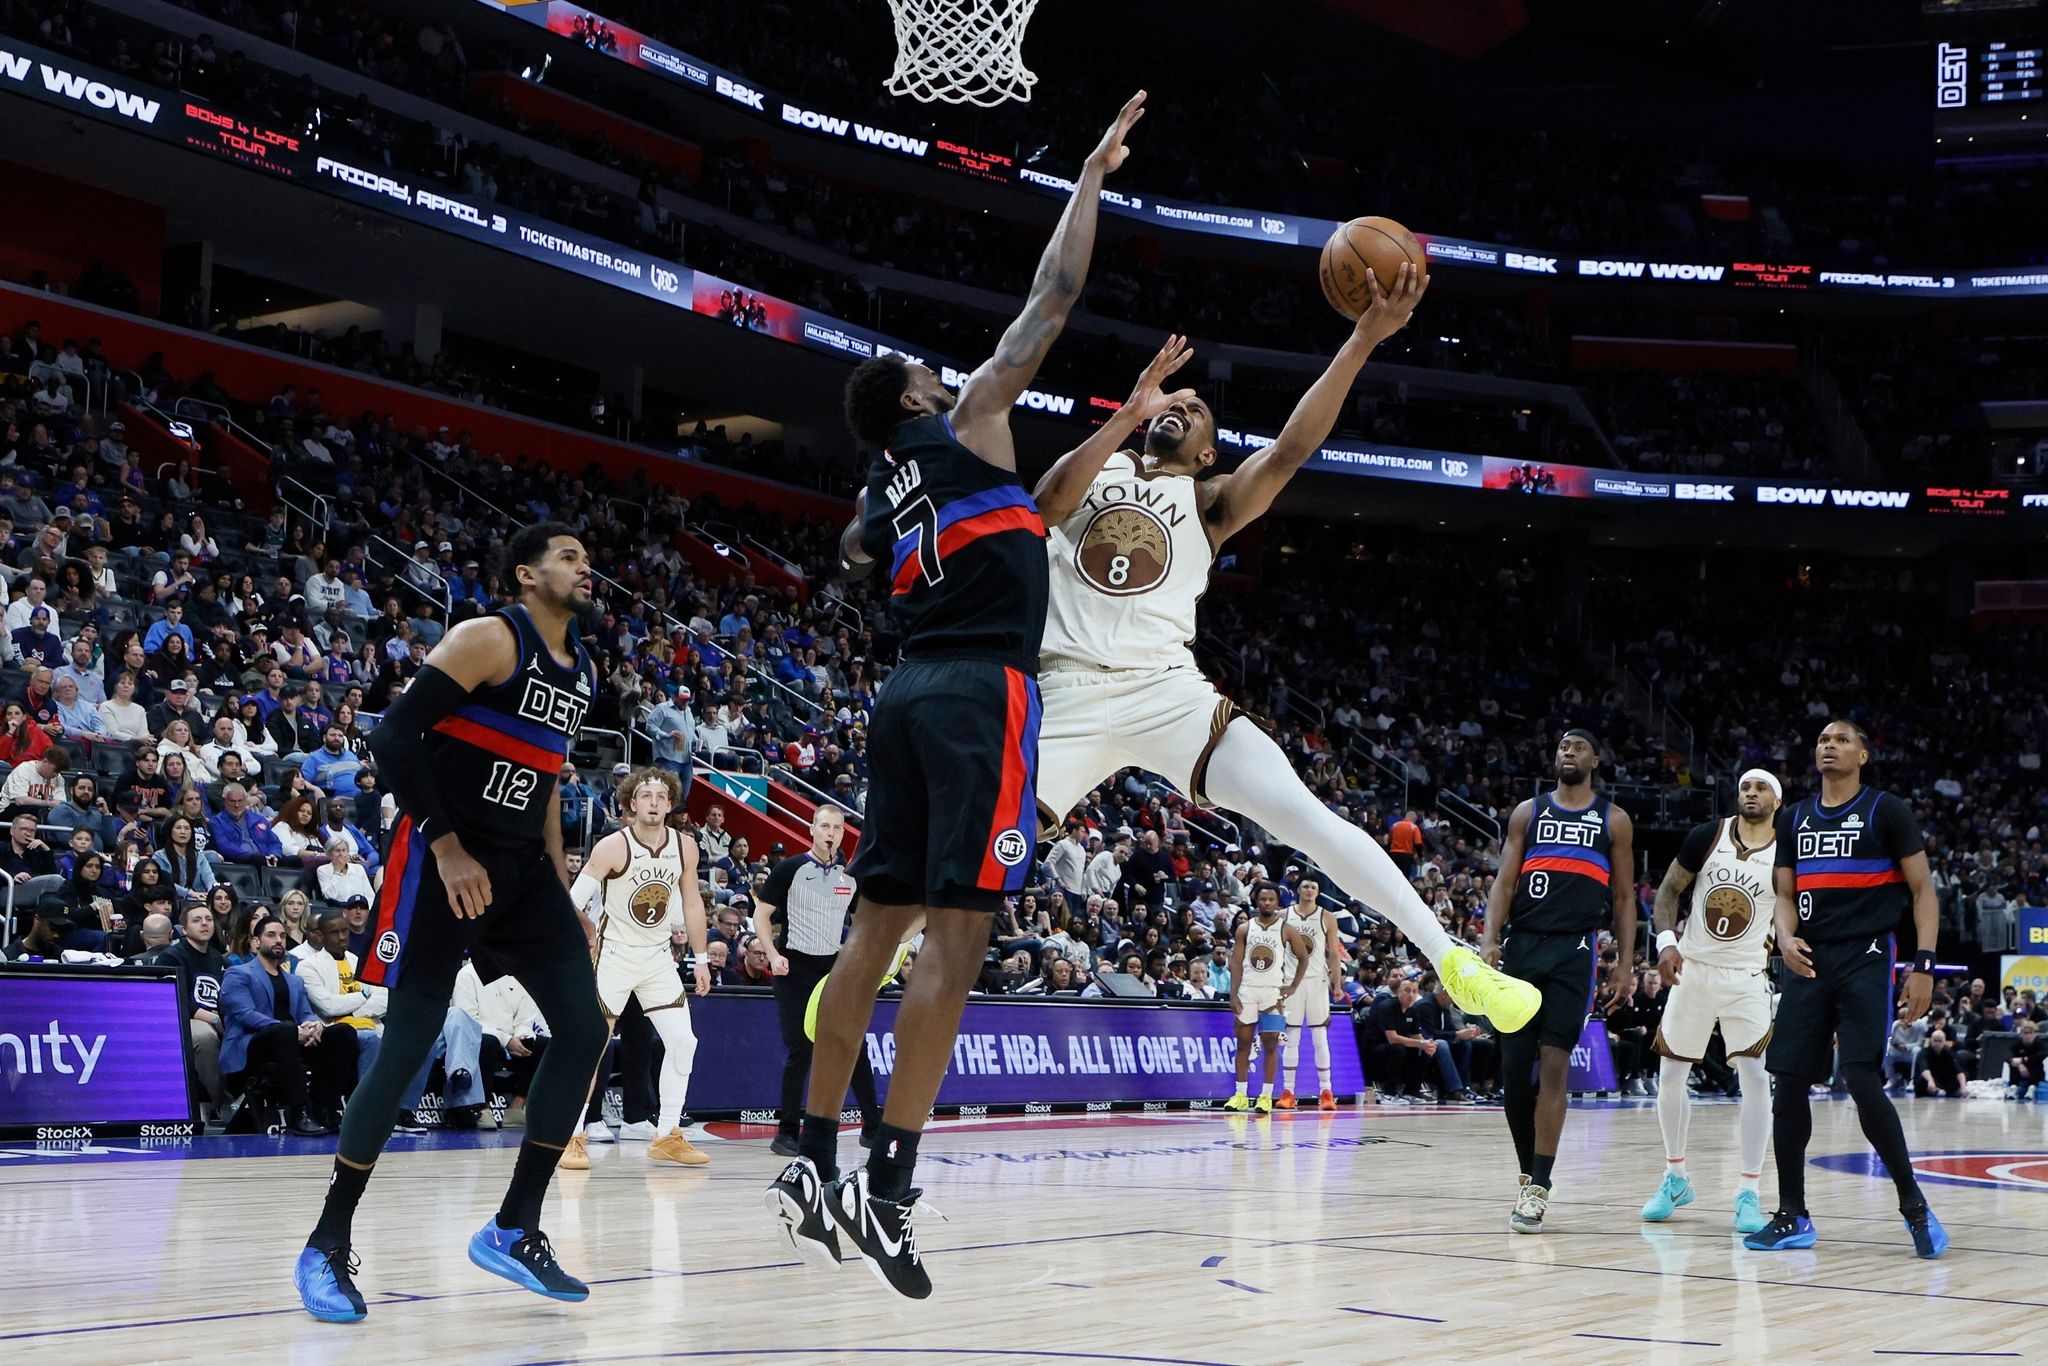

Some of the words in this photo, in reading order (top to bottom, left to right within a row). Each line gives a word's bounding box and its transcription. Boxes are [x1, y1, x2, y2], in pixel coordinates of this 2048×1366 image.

[687, 67, 707, 82] TOUR
[40, 63, 160, 124] WOW
[715, 75, 765, 111] B2K
[185, 103, 234, 130] BOYS
[238, 121, 249, 135] 4
[253, 126, 300, 153] LIFE
[782, 103, 850, 136] BOW
[853, 123, 929, 156] WOW
[219, 131, 267, 158] TOUR
[936, 140, 969, 155] BOYS
[970, 149, 979, 158] 4
[981, 151, 1012, 167] LIFE
[958, 156, 991, 172] TOUR
[316, 155, 412, 206] FRIDAY,
[416, 189, 488, 228] APRIL
[492, 215, 507, 234] 3
[1100, 189, 1129, 207] RIL
[1132, 197, 1142, 210] 3
[1155, 204, 1254, 229] TICKETMASTER.COM
[519, 225, 641, 279] TICKETMASTER.COM
[1475, 252, 1496, 261] TOUR
[1505, 252, 1558, 274] B2K
[1578, 259, 1646, 279] BOW
[1649, 263, 1725, 282] WOW
[1755, 273, 1788, 282] TOUR
[1819, 271, 1886, 287] FRIDAY,
[1887, 275, 1941, 288] APRIL
[1942, 277, 1955, 288] 3
[807, 326, 850, 347] MILLENNIUM
[851, 340, 870, 354] TOUR
[1320, 448, 1434, 472] TICKETMASTER.COM
[884, 459, 922, 509] REED
[1644, 486, 1667, 494] TOUR
[1675, 483, 1735, 501] B2K
[1081, 483, 1187, 528] TOWN
[1757, 486, 1827, 505] BOW
[1831, 489, 1911, 508] WOW
[1951, 499, 1985, 508] TOUR
[892, 494, 945, 587] 7
[1108, 555, 1131, 586] 8
[518, 677, 589, 736] DET
[483, 761, 538, 811] 12
[1536, 819, 1601, 848] DET
[1797, 830, 1861, 859] DET
[1000, 839, 1022, 856] DET
[628, 866, 679, 886] TOWN
[1528, 870, 1550, 899] 8
[1706, 867, 1765, 898] TOWN
[646, 907, 656, 924] 2
[1799, 891, 1813, 921] 9
[1716, 916, 1730, 936] 0
[380, 942, 398, 955] DET
[1248, 935, 1279, 949] TOWN
[1255, 959, 1266, 970] 18
[0, 1019, 107, 1085] nity
[953, 1034, 999, 1075] THE
[999, 1035, 1065, 1076] NBA.
[1068, 1035, 1109, 1075] ALL
[1109, 1035, 1136, 1074] IN
[1142, 1036, 1179, 1074] ONE
[740, 1109, 776, 1120] StockX
[840, 1109, 862, 1119] ockX
[959, 1105, 988, 1116] StockX
[1024, 1103, 1052, 1114] StockX
[1086, 1101, 1112, 1112] StockX
[1143, 1101, 1168, 1111] StockX
[36, 1126, 93, 1140] StockX
[140, 1123, 194, 1137] StockX
